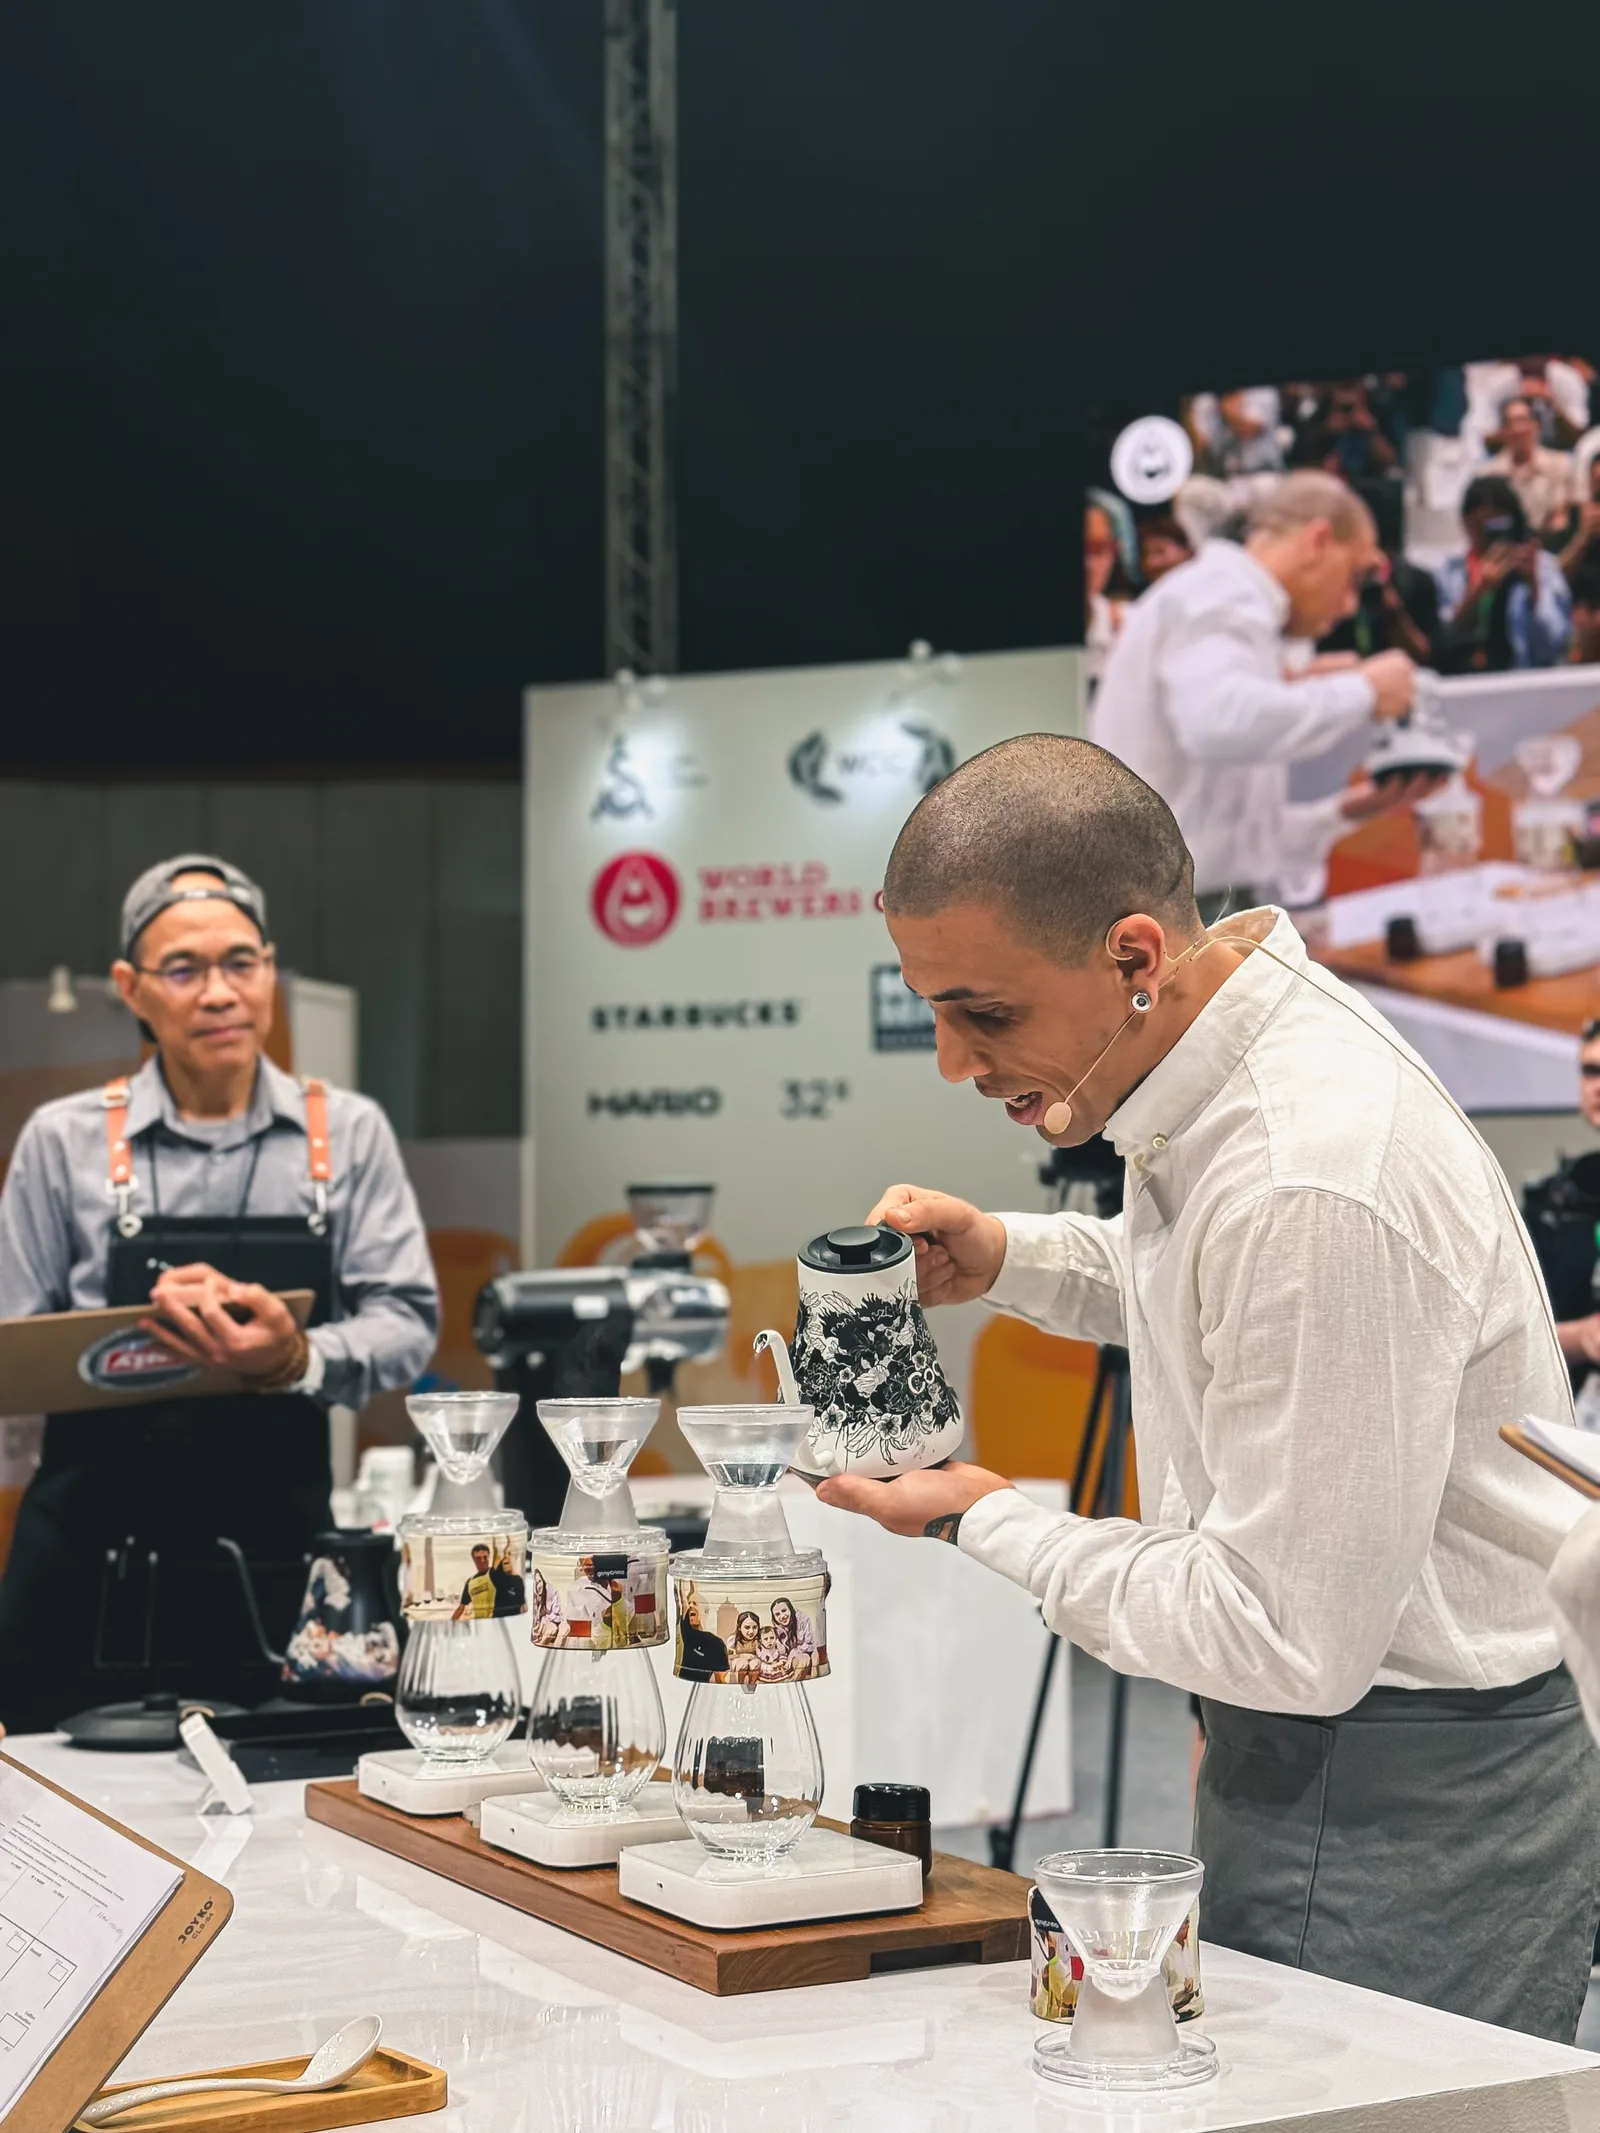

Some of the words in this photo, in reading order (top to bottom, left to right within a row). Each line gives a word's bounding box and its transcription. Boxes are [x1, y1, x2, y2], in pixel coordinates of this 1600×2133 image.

[698, 863, 827, 889] WORLD
[698, 889, 862, 922] BREWERS
[591, 1000, 801, 1031] STARBUCKS
[177, 1900, 214, 1945] JOYKO
